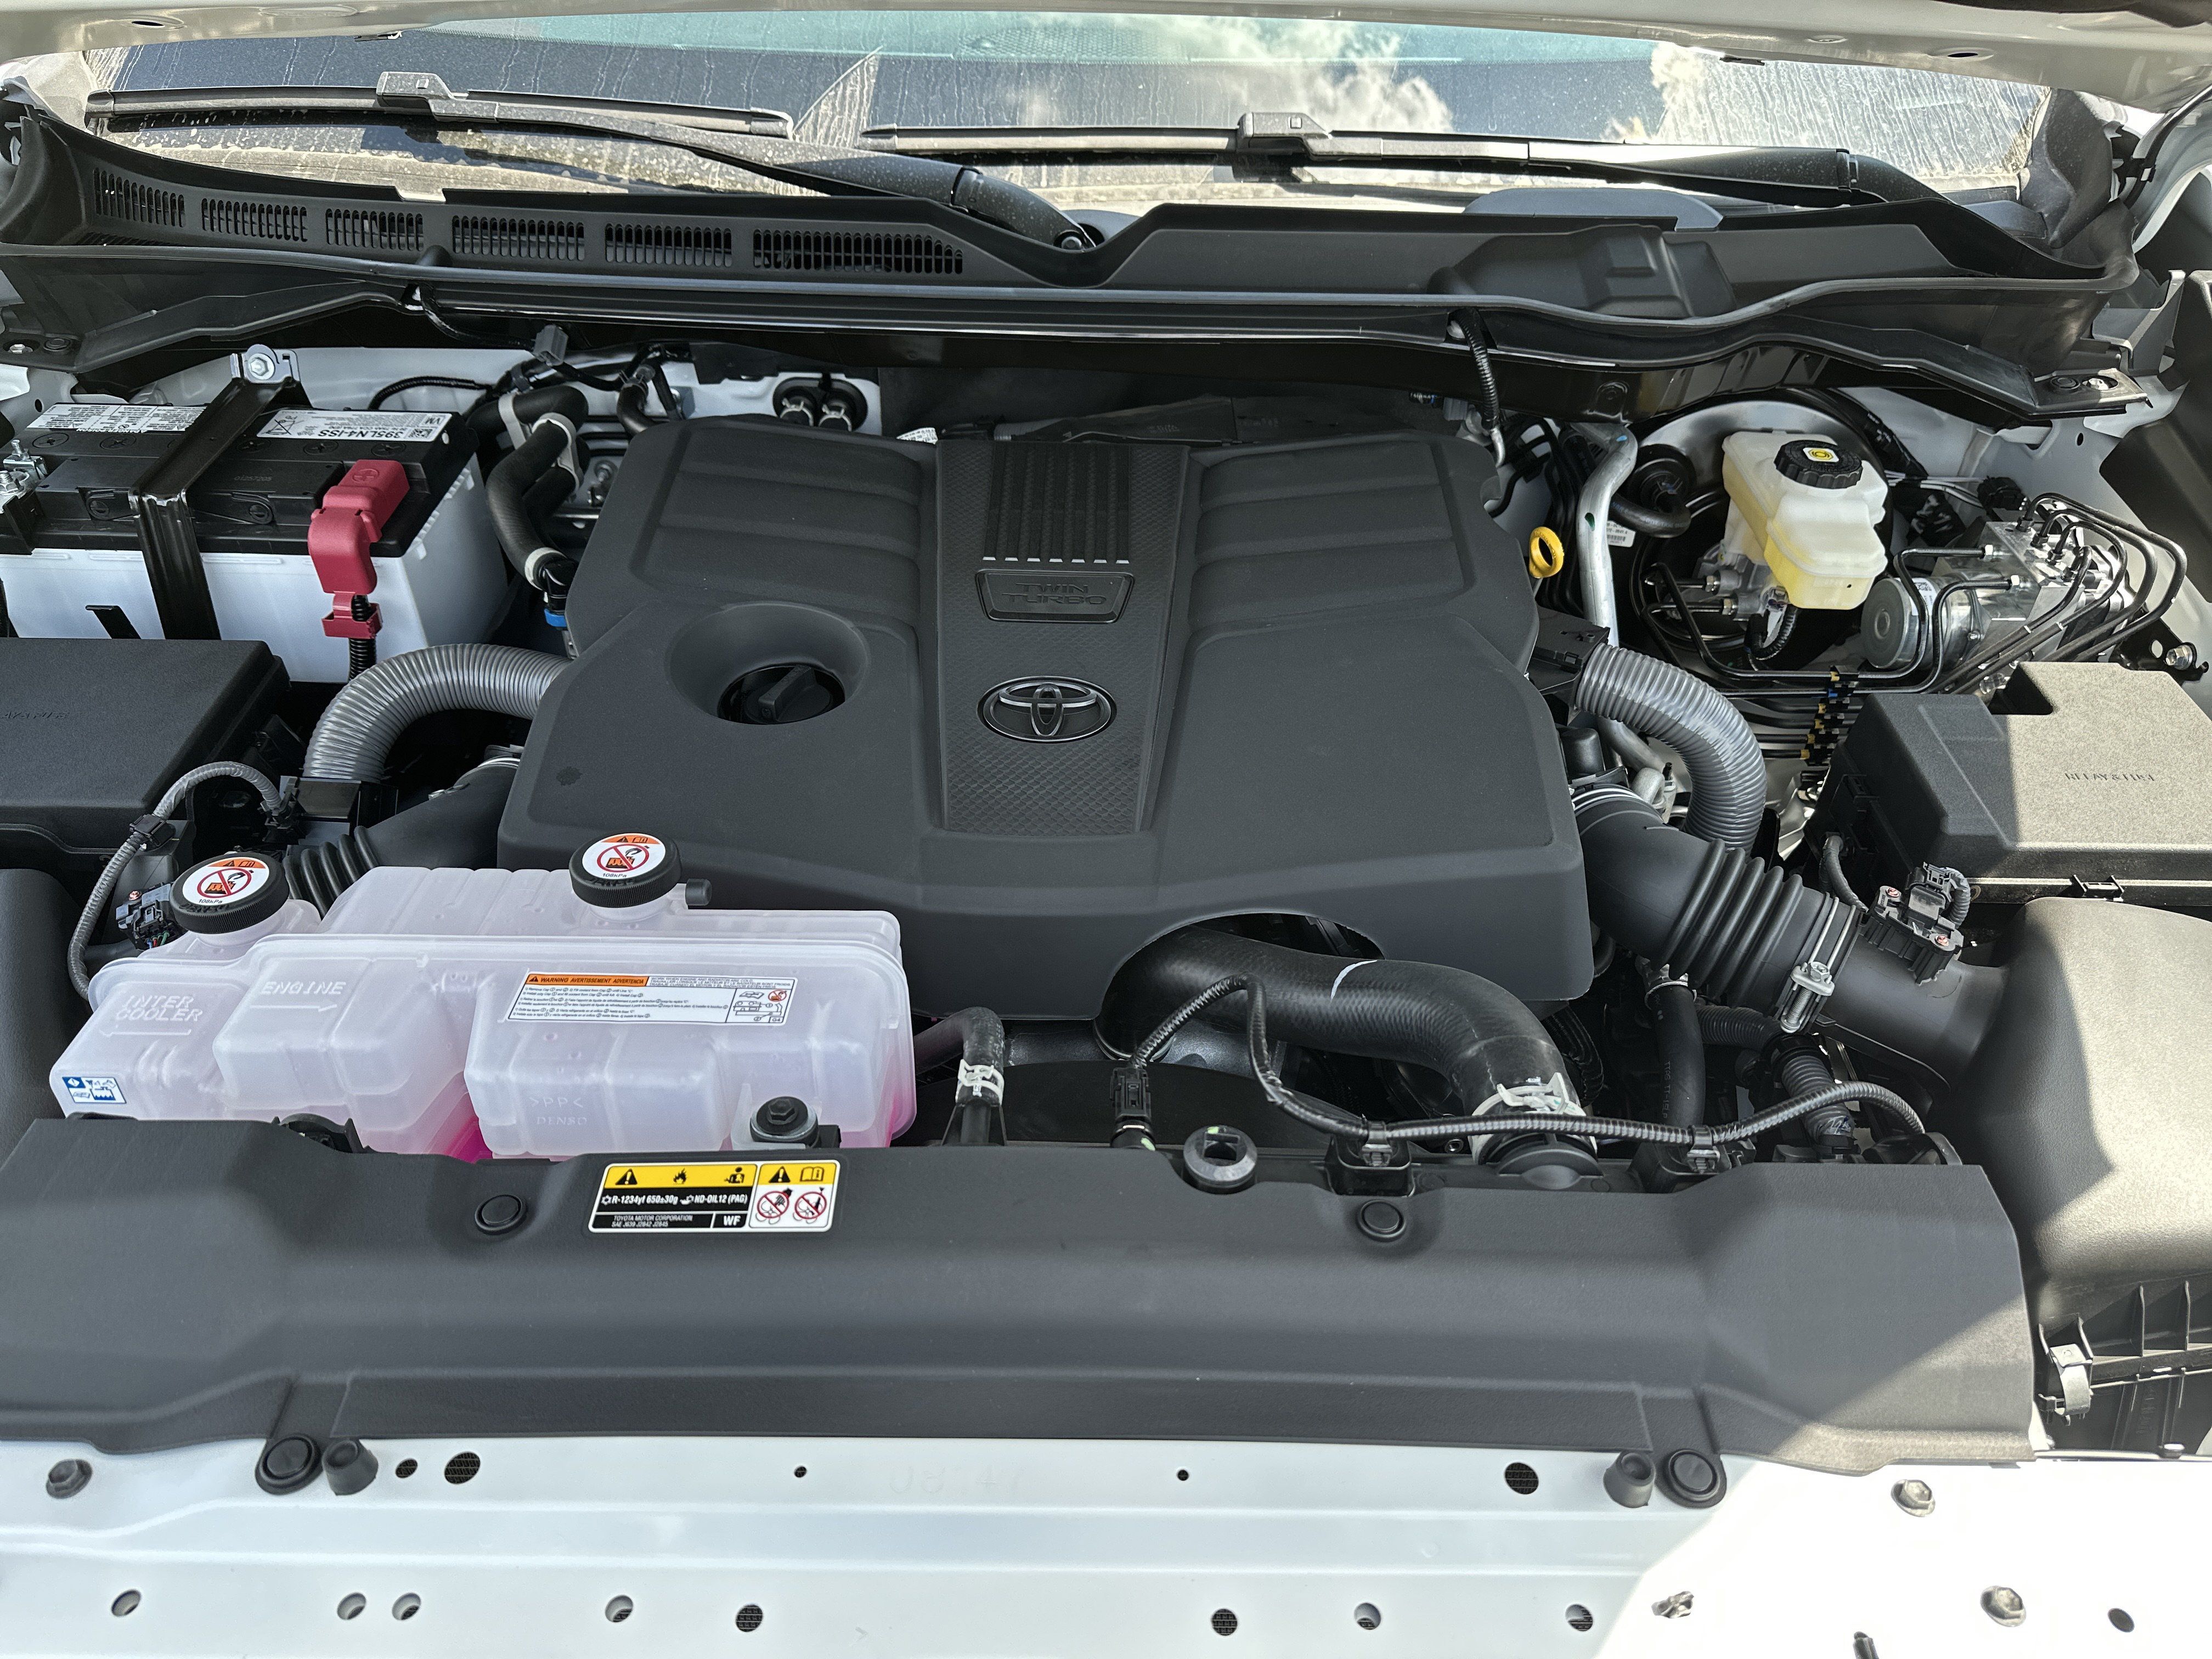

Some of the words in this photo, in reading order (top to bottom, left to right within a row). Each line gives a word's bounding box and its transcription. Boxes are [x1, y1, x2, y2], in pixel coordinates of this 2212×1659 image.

[318, 429, 404, 438] 395LN4-ISS
[1017, 583, 1088, 594] TWIN
[1002, 593, 1106, 604] TURBO
[260, 981, 346, 995] ENGINE
[122, 995, 194, 1008] INTER
[116, 1007, 203, 1022] COOLER
[537, 1116, 587, 1125] DENSO
[728, 1194, 748, 1205] (PAG)
[723, 1215, 741, 1227] WF
